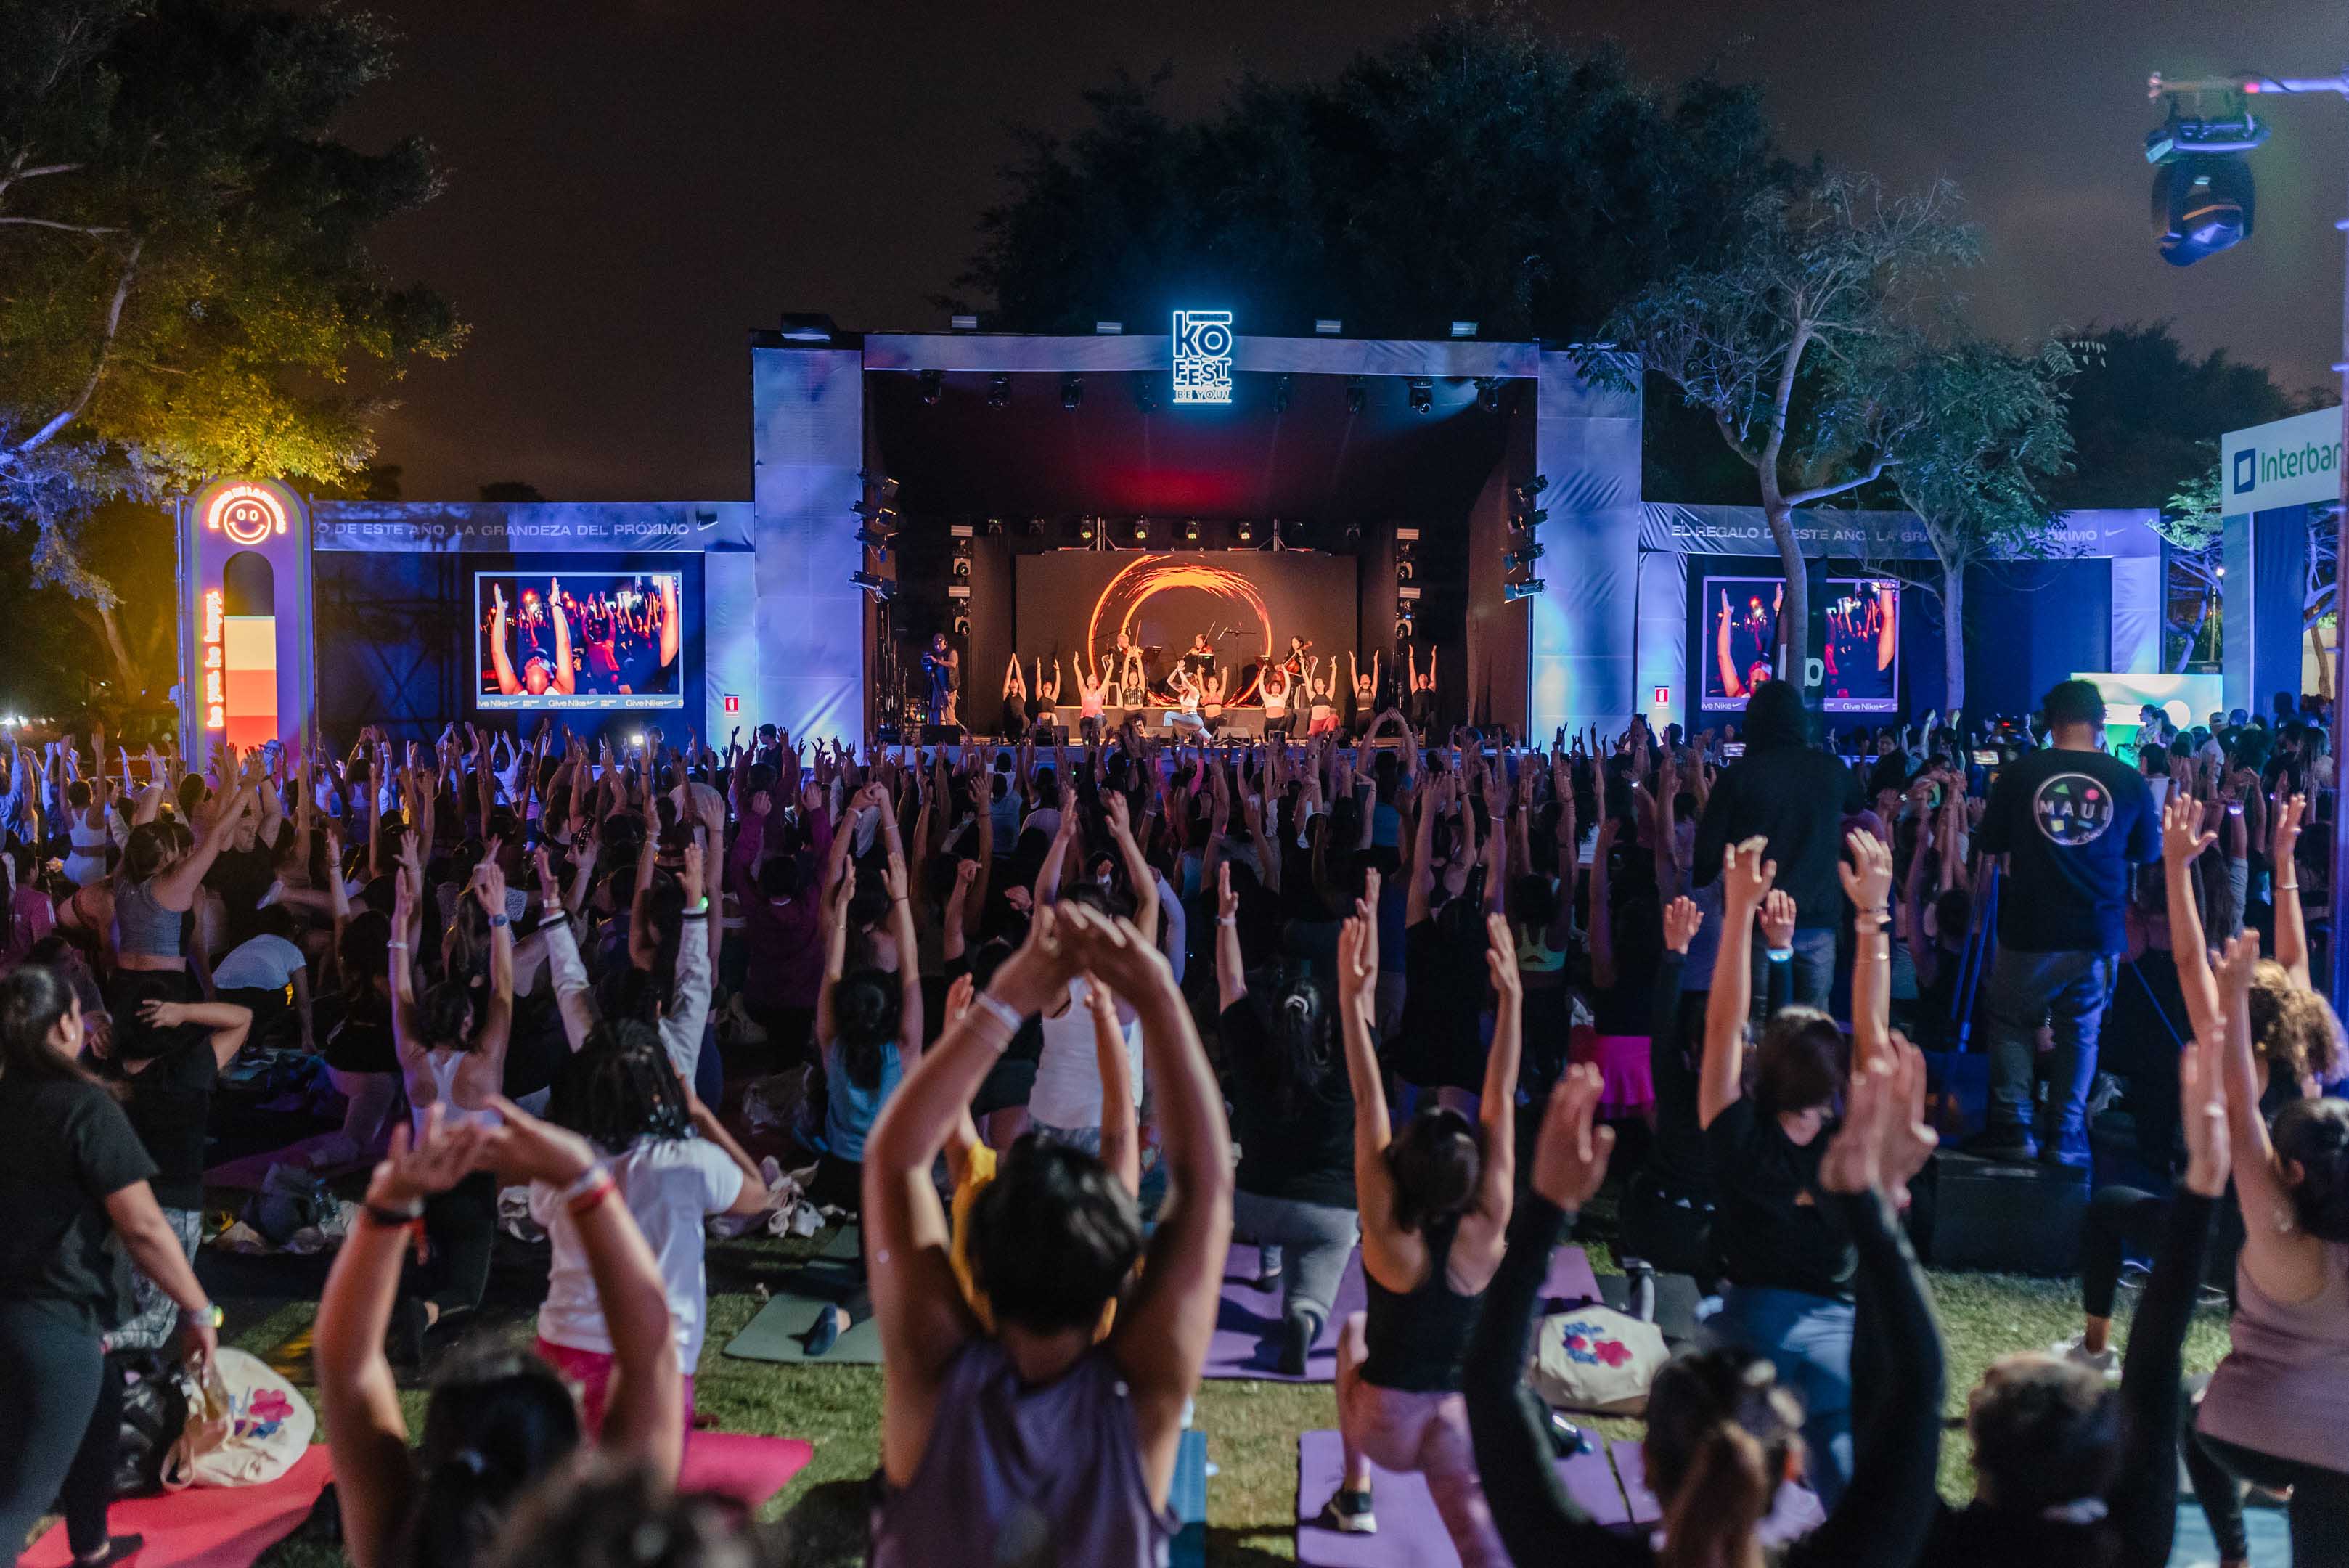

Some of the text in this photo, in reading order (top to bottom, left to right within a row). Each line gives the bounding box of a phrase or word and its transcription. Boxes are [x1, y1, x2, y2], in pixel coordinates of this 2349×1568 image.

[1173, 358, 1232, 387] FEST
[1176, 390, 1193, 399] BE
[2261, 441, 2342, 483] Interban
[335, 523, 357, 534] DE
[362, 523, 403, 535] ESTE
[454, 524, 475, 536] LA
[481, 524, 571, 537] GRANDEZA
[576, 525, 608, 536] DEL
[613, 521, 690, 536] PRÓXIMO
[1672, 525, 1691, 536] EL
[1694, 526, 1759, 539] REGALO
[2038, 799, 2109, 820] MAUI
